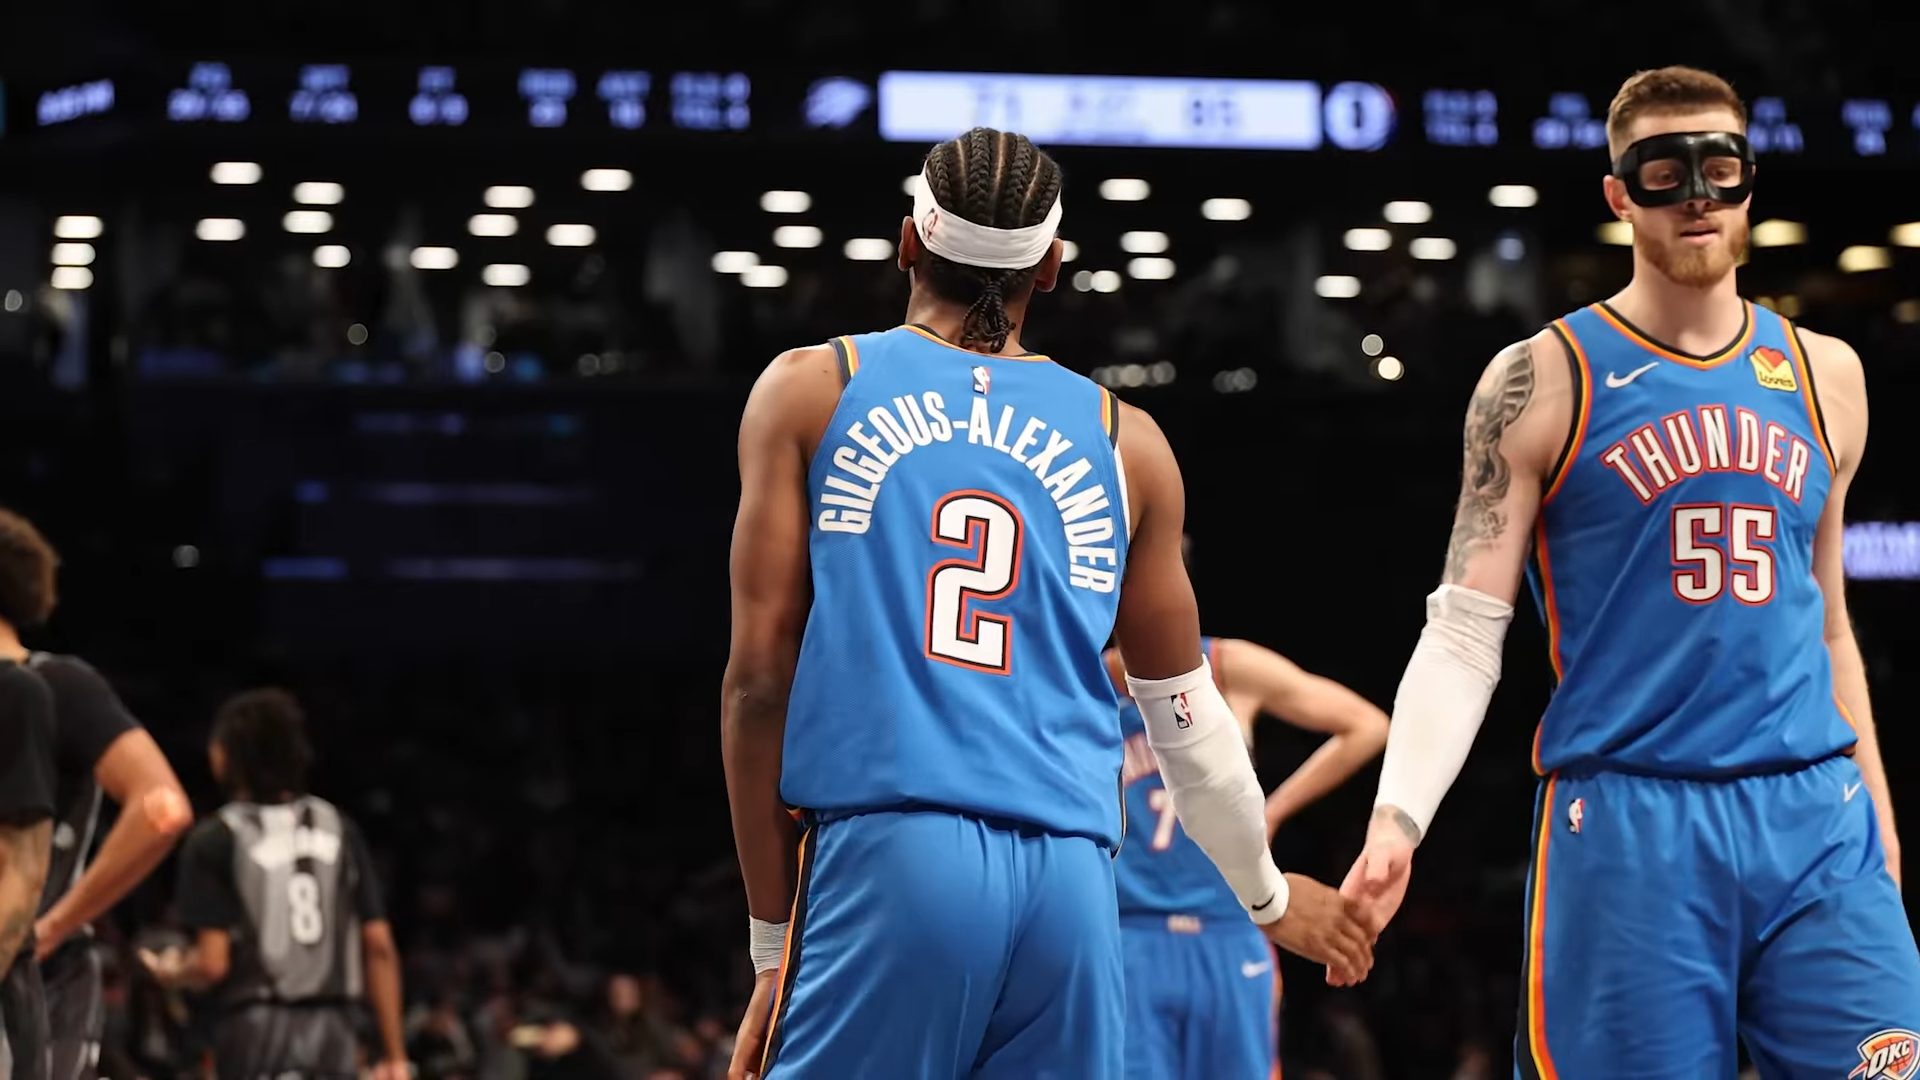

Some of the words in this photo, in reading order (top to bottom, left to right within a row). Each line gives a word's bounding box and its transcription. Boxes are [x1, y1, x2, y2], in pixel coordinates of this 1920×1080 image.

[818, 390, 1116, 594] GILGEOUS-ALEXANDER
[1601, 405, 1808, 504] THUNDER
[925, 488, 1024, 676] 2
[1671, 503, 1776, 605] 55
[1149, 788, 1175, 850] 7
[288, 873, 322, 944] 8
[1867, 1040, 1910, 1079] OKC
